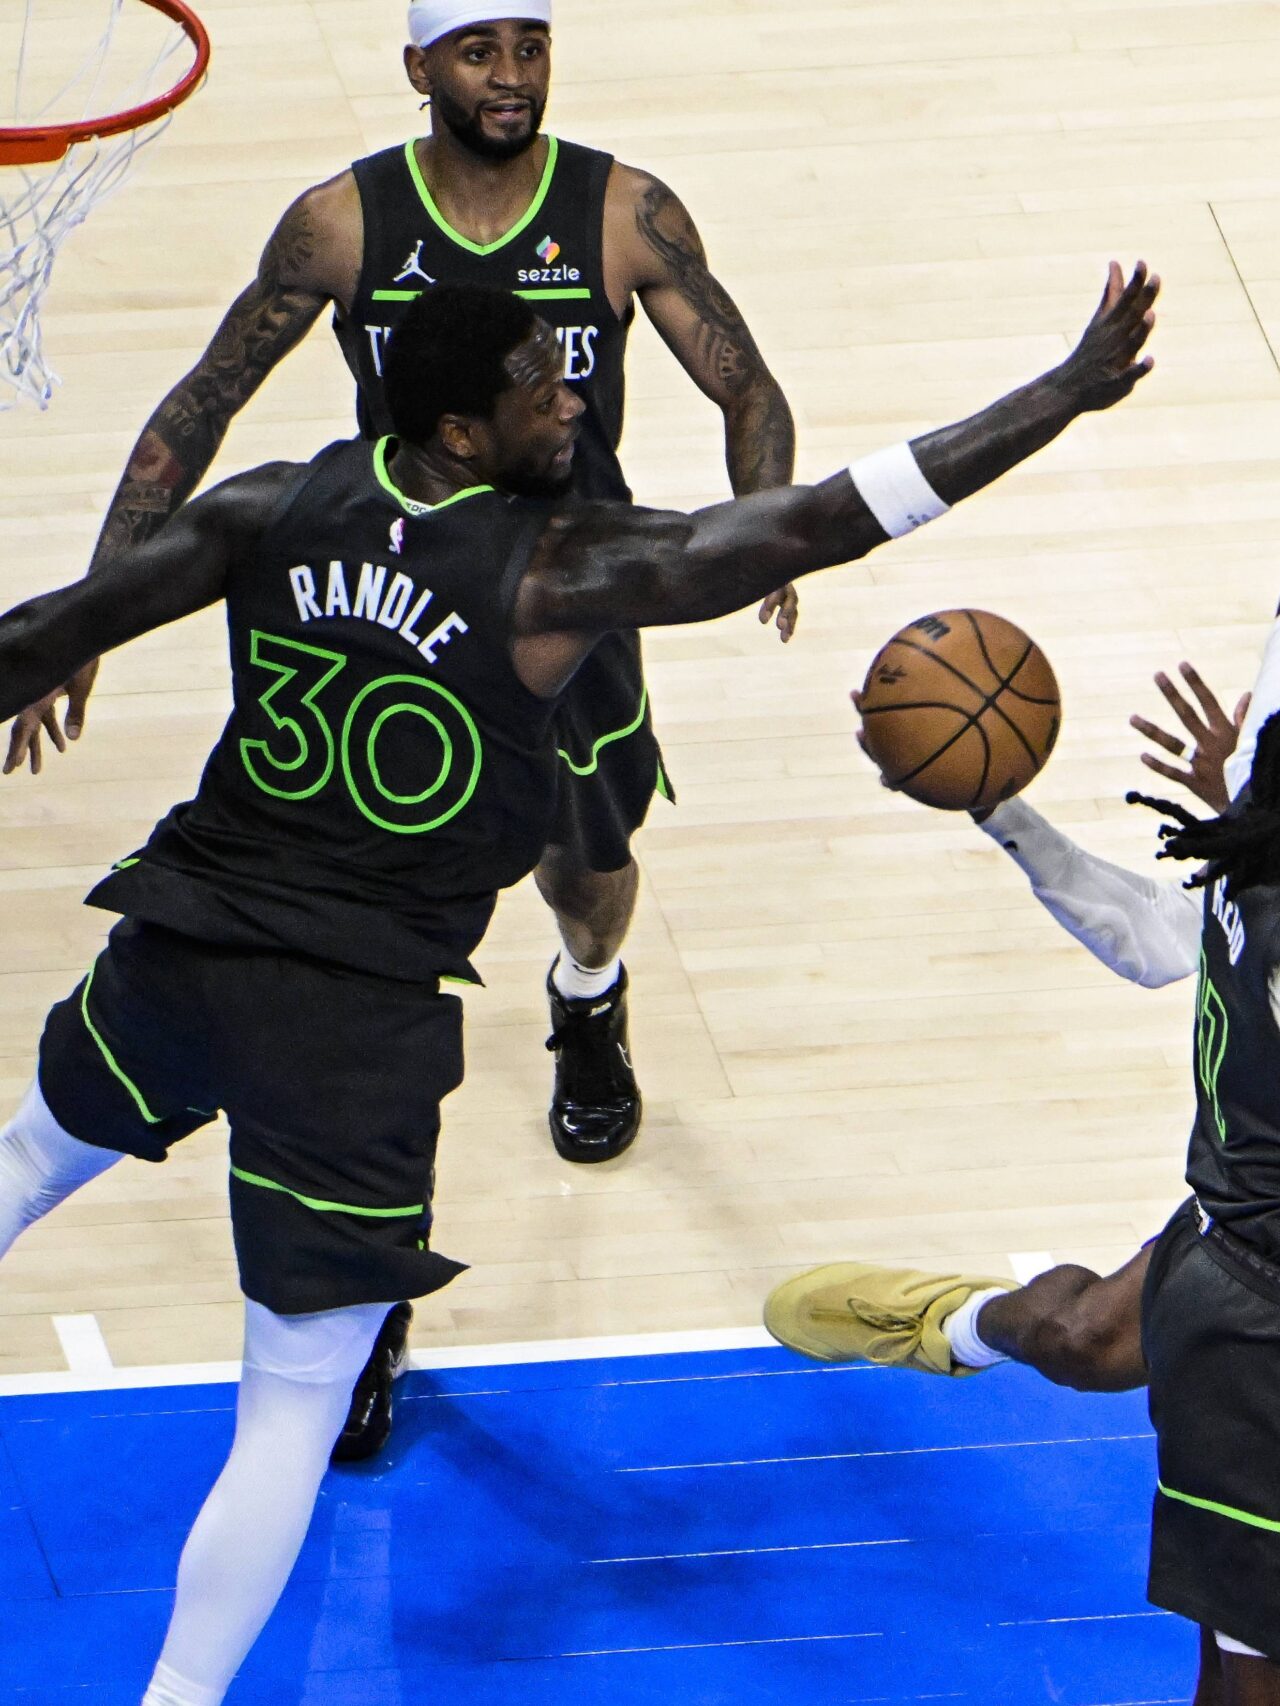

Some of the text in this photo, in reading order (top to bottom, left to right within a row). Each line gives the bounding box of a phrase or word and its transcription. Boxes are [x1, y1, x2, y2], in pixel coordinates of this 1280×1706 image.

[517, 263, 580, 282] sezzle
[288, 560, 469, 664] RANDLE
[240, 629, 482, 834] 30
